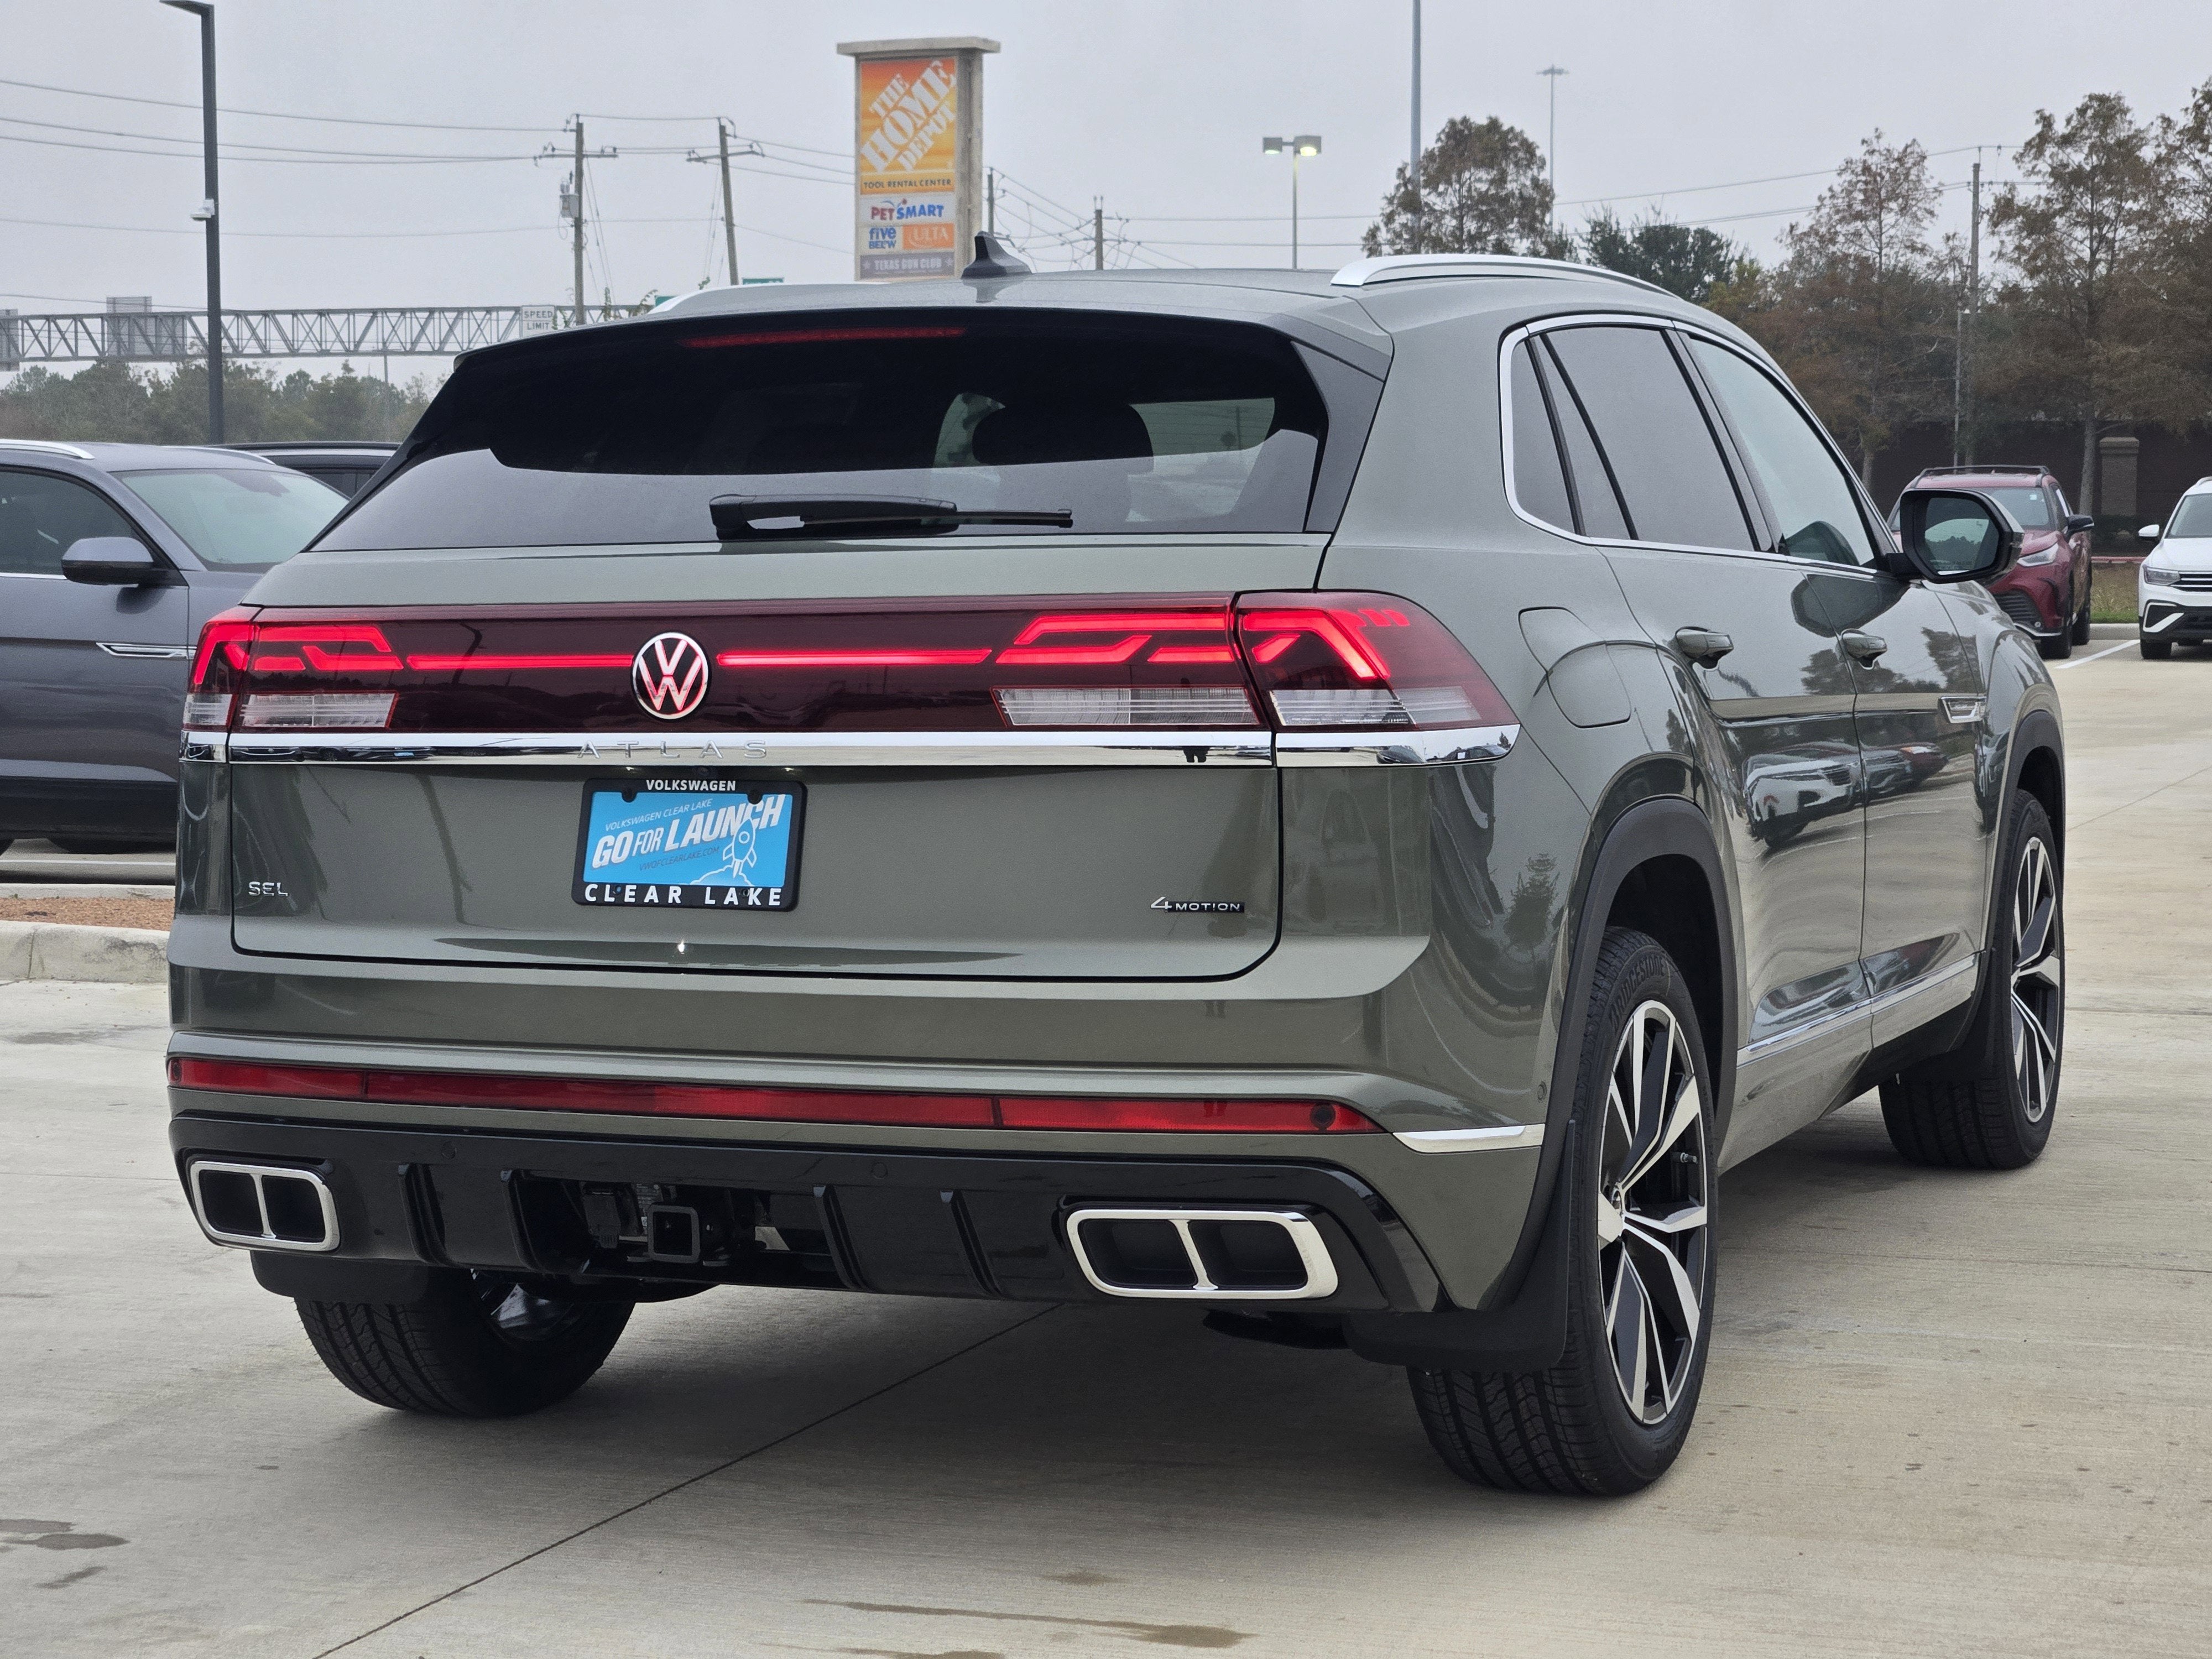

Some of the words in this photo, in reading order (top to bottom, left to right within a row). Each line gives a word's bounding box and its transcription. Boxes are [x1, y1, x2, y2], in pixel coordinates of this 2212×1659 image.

[869, 73, 910, 118] THE
[860, 61, 957, 175] HOME
[897, 101, 957, 172] DEPOT
[887, 180, 918, 188] RENTAL
[919, 178, 951, 186] CENTER
[869, 227, 896, 240] five
[524, 311, 553, 319] SPEED
[577, 740, 768, 759] ATLAS
[646, 779, 736, 791] VOLKSWAGEN
[605, 811, 662, 832] VOLKSWAGEN
[663, 804, 690, 818] CLEAR
[691, 798, 713, 811] LAKE
[592, 830, 634, 869] GO
[632, 827, 665, 857] FOR
[664, 794, 786, 852] LAUNCH
[248, 881, 288, 896] SEL
[585, 883, 682, 905] CLEAR
[704, 885, 782, 906] LAKE
[1150, 896, 1240, 913] 4MOTION
[1608, 953, 1665, 1029] BRIDGESTONE
